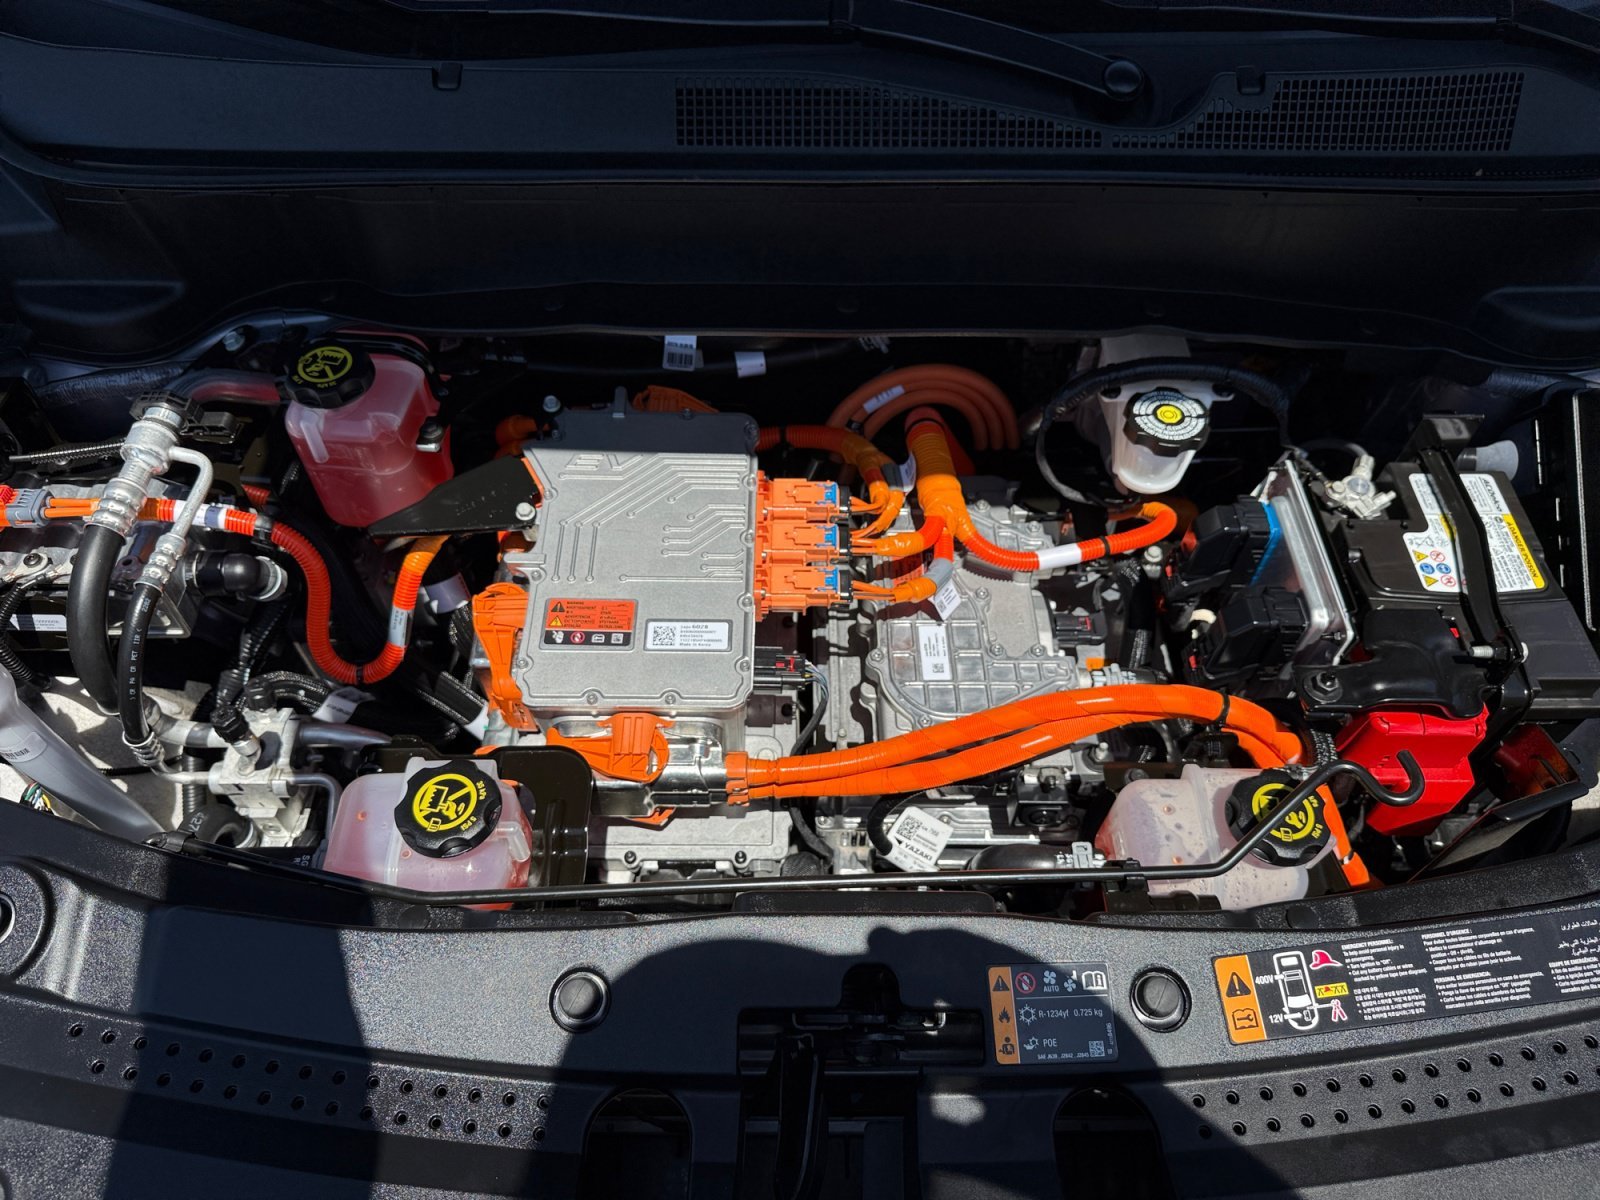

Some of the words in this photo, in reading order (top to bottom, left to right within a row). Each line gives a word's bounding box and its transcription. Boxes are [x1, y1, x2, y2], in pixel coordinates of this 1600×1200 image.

[904, 842, 933, 861] YAZAKI
[1255, 974, 1274, 985] 400V
[1038, 1009, 1069, 1019] R-1234yf
[1073, 1008, 1093, 1017] 0.725
[1094, 1008, 1103, 1017] kg
[1268, 1014, 1284, 1024] 12V
[1043, 1038, 1058, 1048] POE
